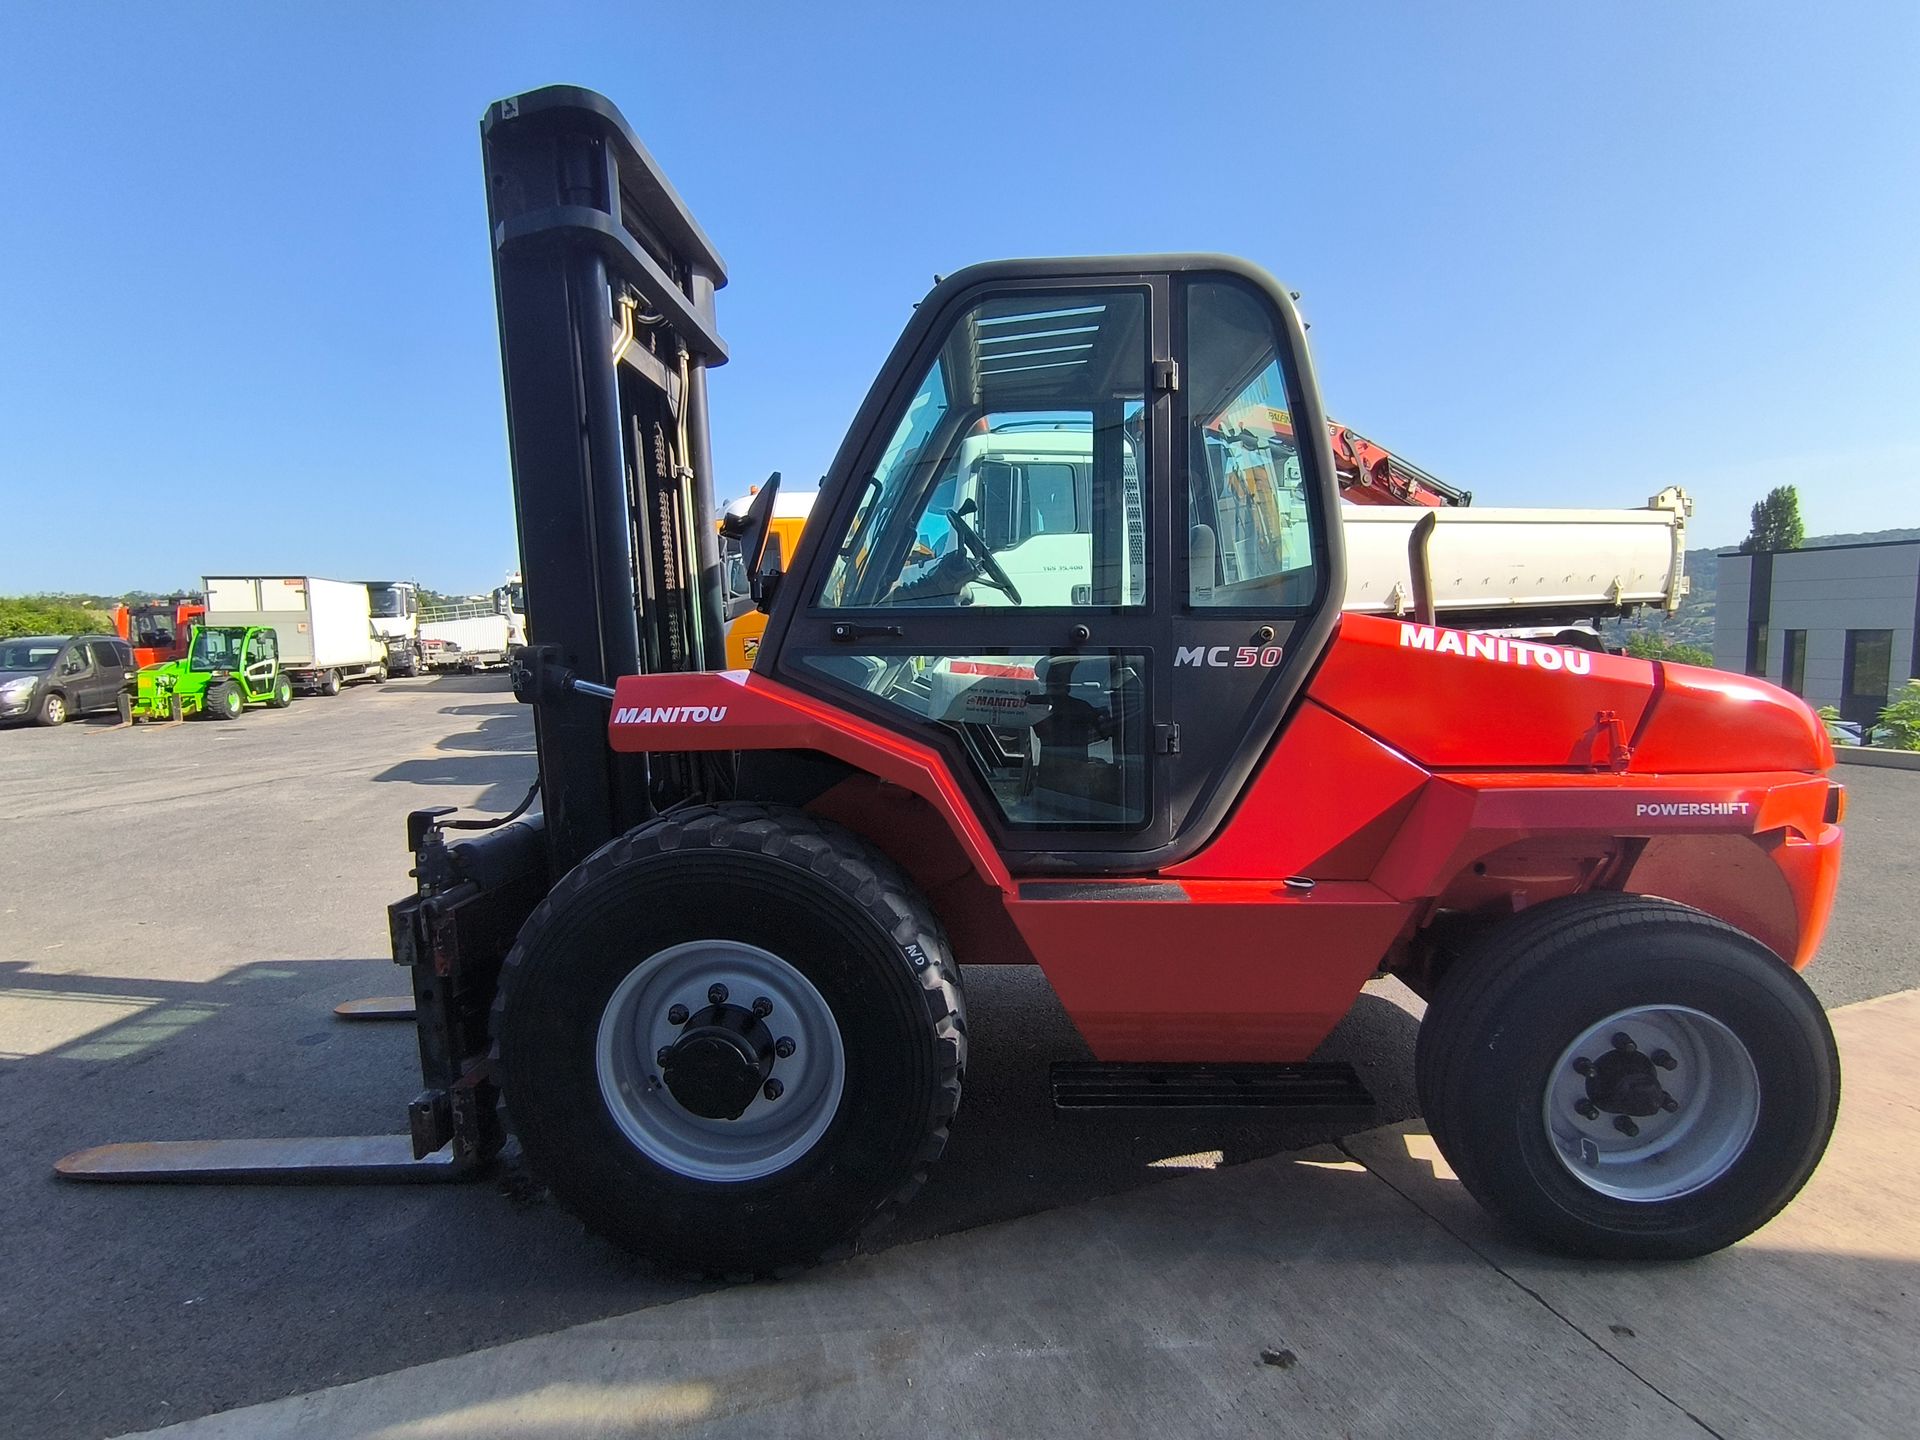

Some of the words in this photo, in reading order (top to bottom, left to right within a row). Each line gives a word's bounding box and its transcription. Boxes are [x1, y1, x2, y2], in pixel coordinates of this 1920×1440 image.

[1399, 623, 1590, 675] MANITOU
[614, 706, 727, 723] MANITOU
[1636, 802, 1749, 816] POWERSHIFT
[904, 944, 925, 966] AVD
